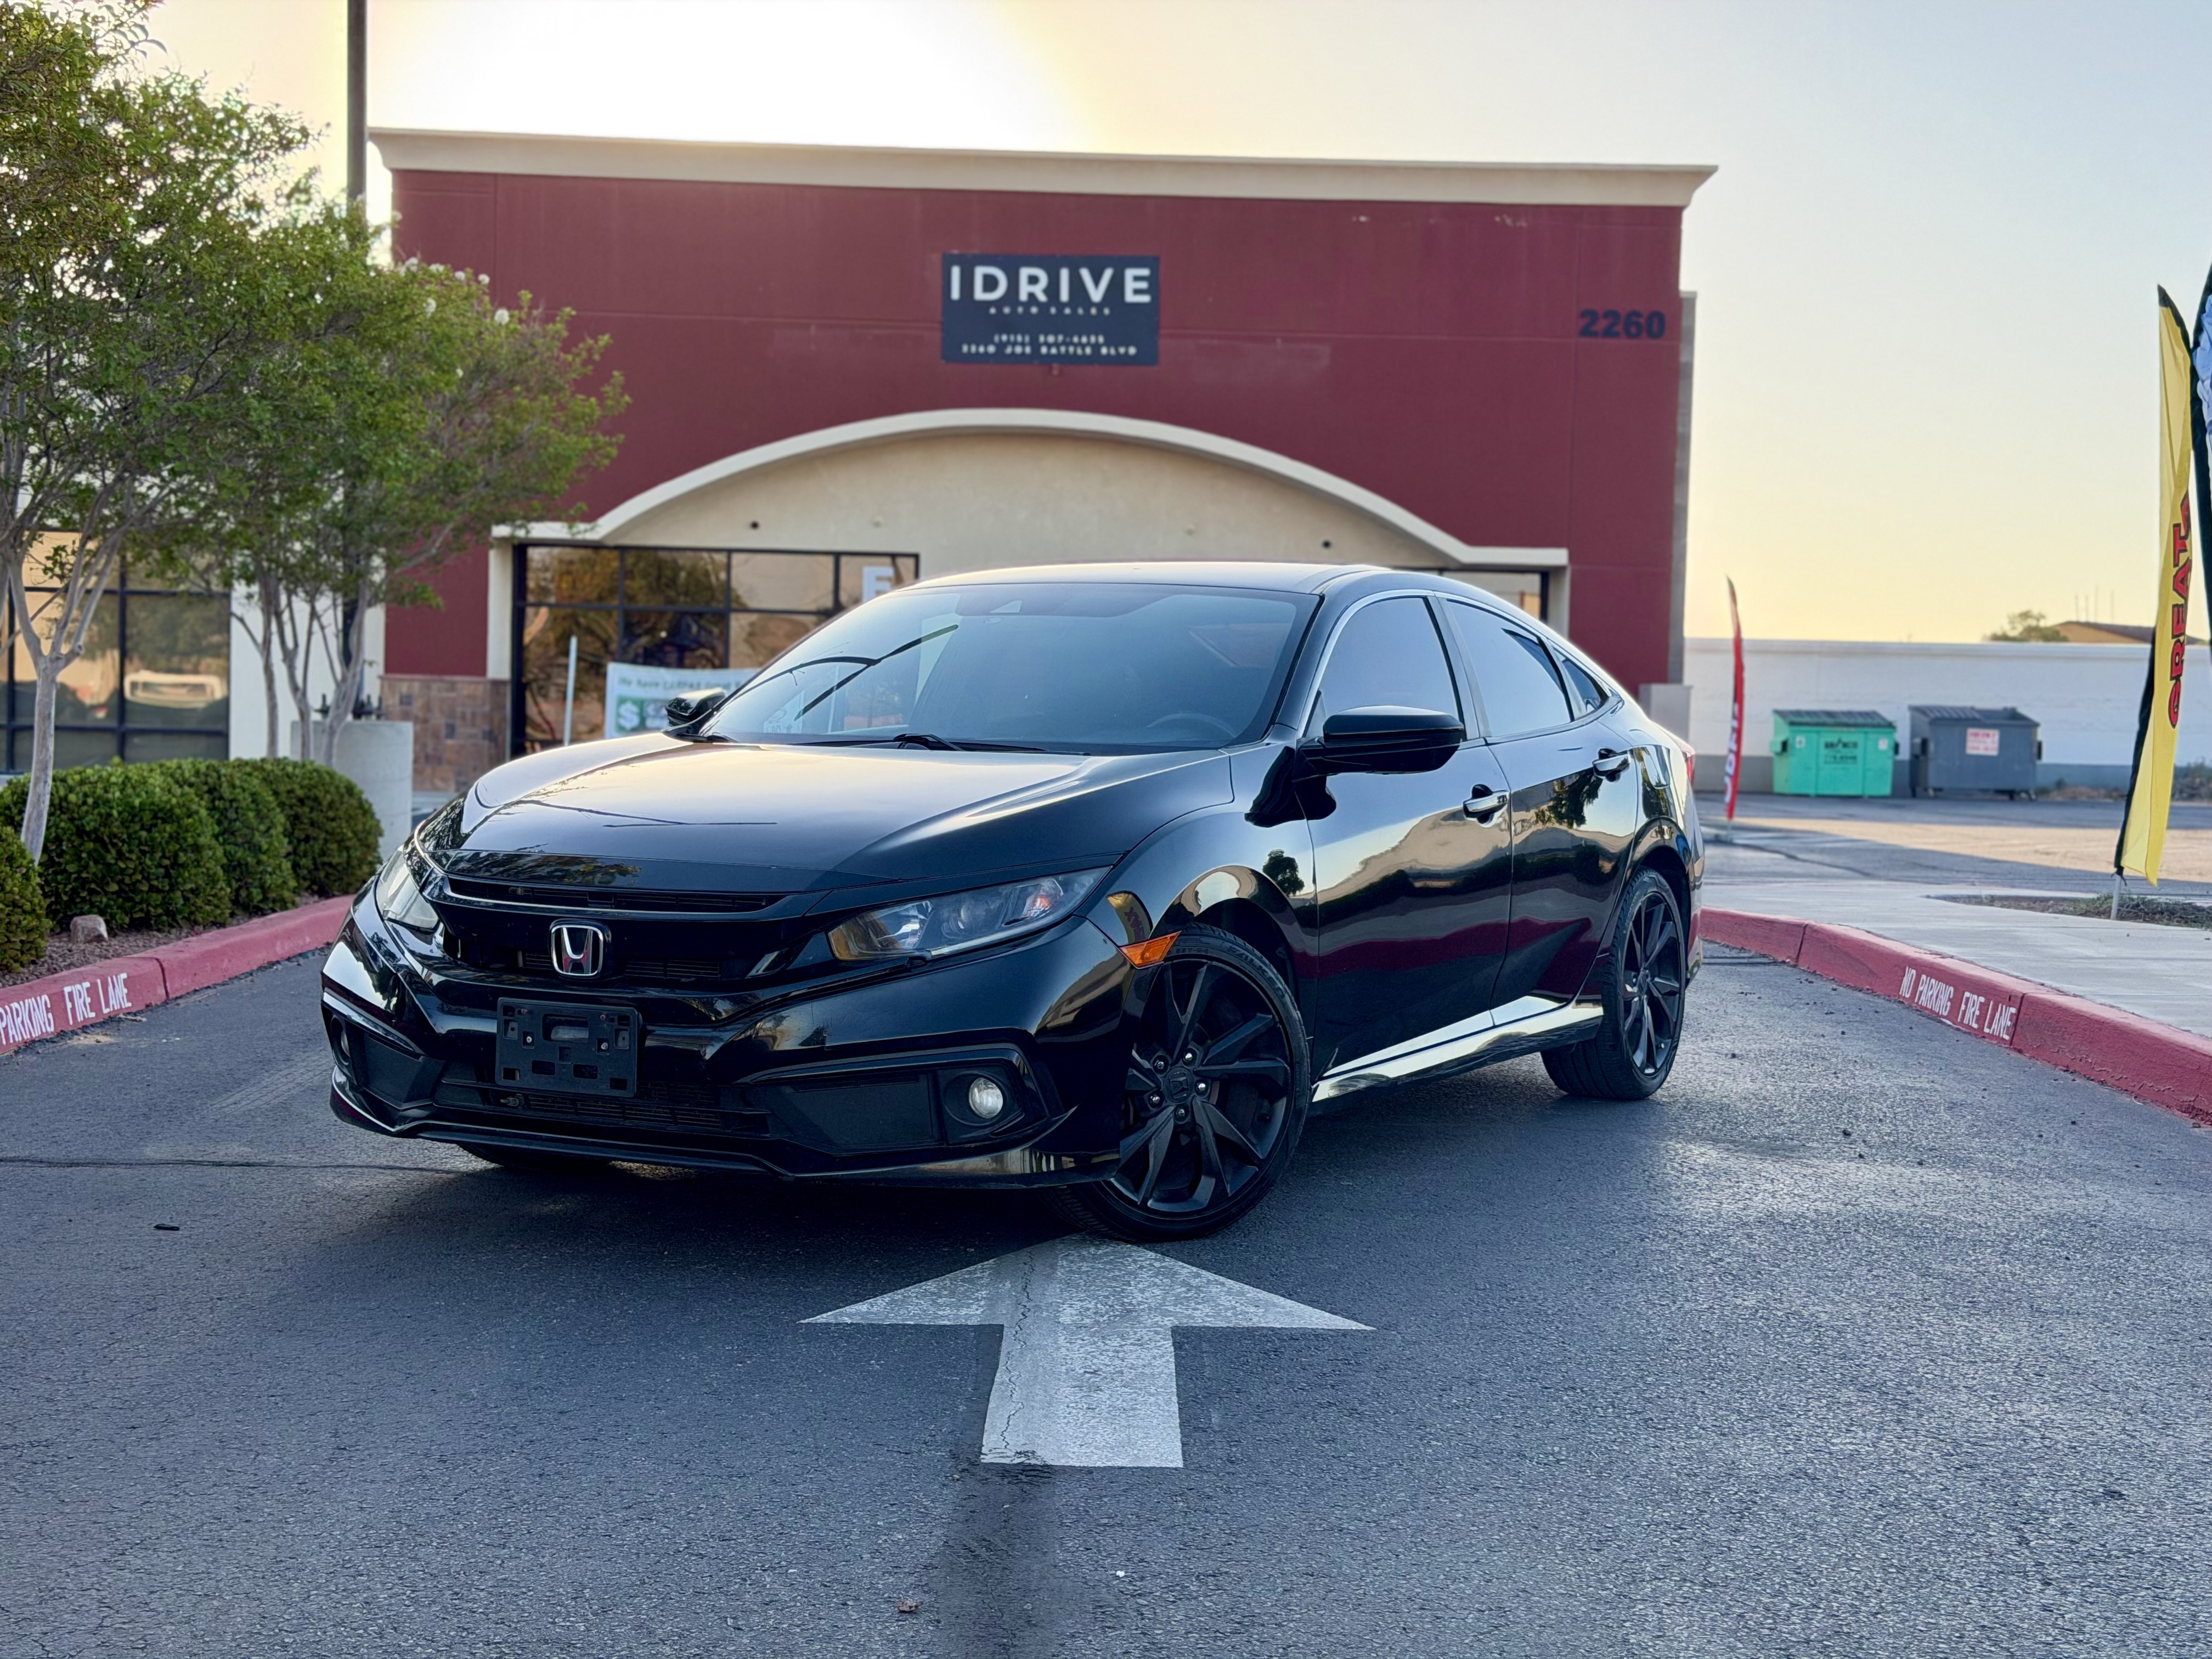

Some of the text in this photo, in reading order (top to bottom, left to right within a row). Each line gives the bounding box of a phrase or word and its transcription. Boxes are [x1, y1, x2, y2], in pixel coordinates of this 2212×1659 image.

[950, 266, 1151, 303] IDRIVE
[1579, 309, 1666, 339] 2260
[1004, 345, 1031, 354] JOE
[1040, 345, 1092, 356] BATTLE
[1100, 346, 1137, 356] BLVD
[0, 973, 132, 1045] PARKING FIRE LANE
[1899, 966, 2016, 1040] NO PARKING FIRE LANE
